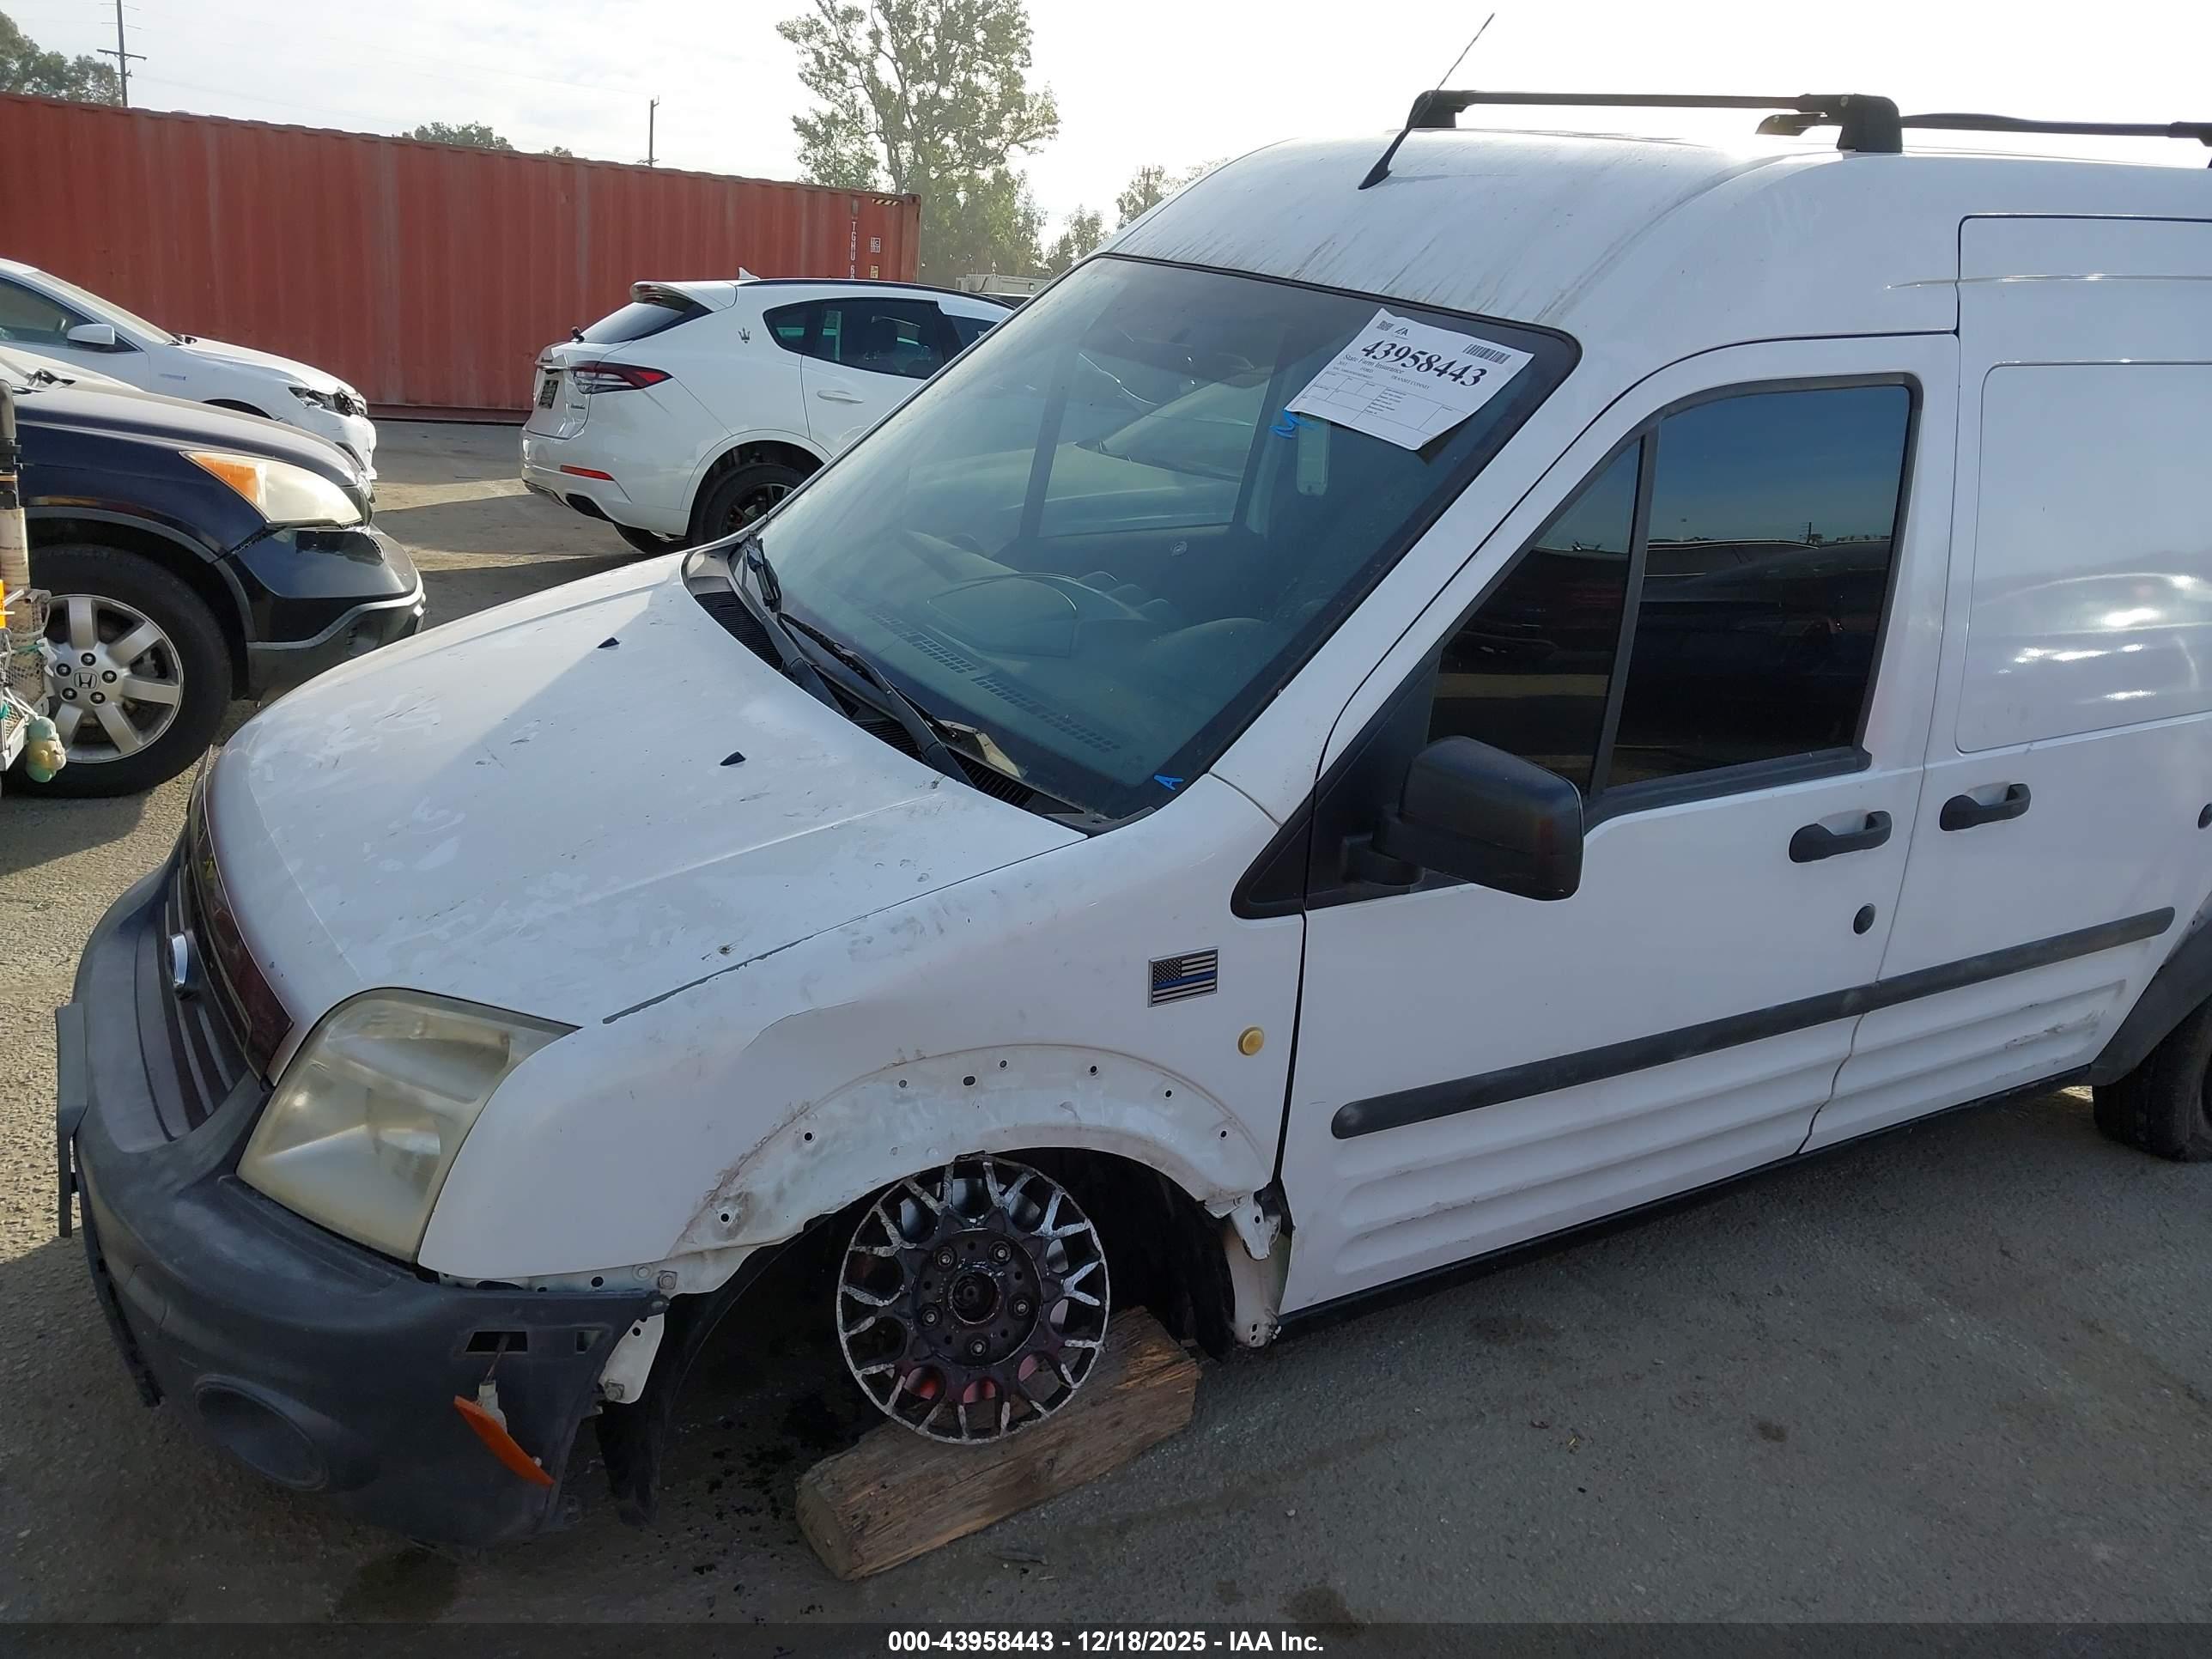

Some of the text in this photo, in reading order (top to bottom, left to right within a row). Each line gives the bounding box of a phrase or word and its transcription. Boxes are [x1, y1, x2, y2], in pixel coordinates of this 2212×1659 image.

[1343, 354, 1358, 362] State
[1358, 357, 1374, 368] Farm
[1374, 362, 1406, 375] Insurance
[1361, 340, 1487, 386] 43958443
